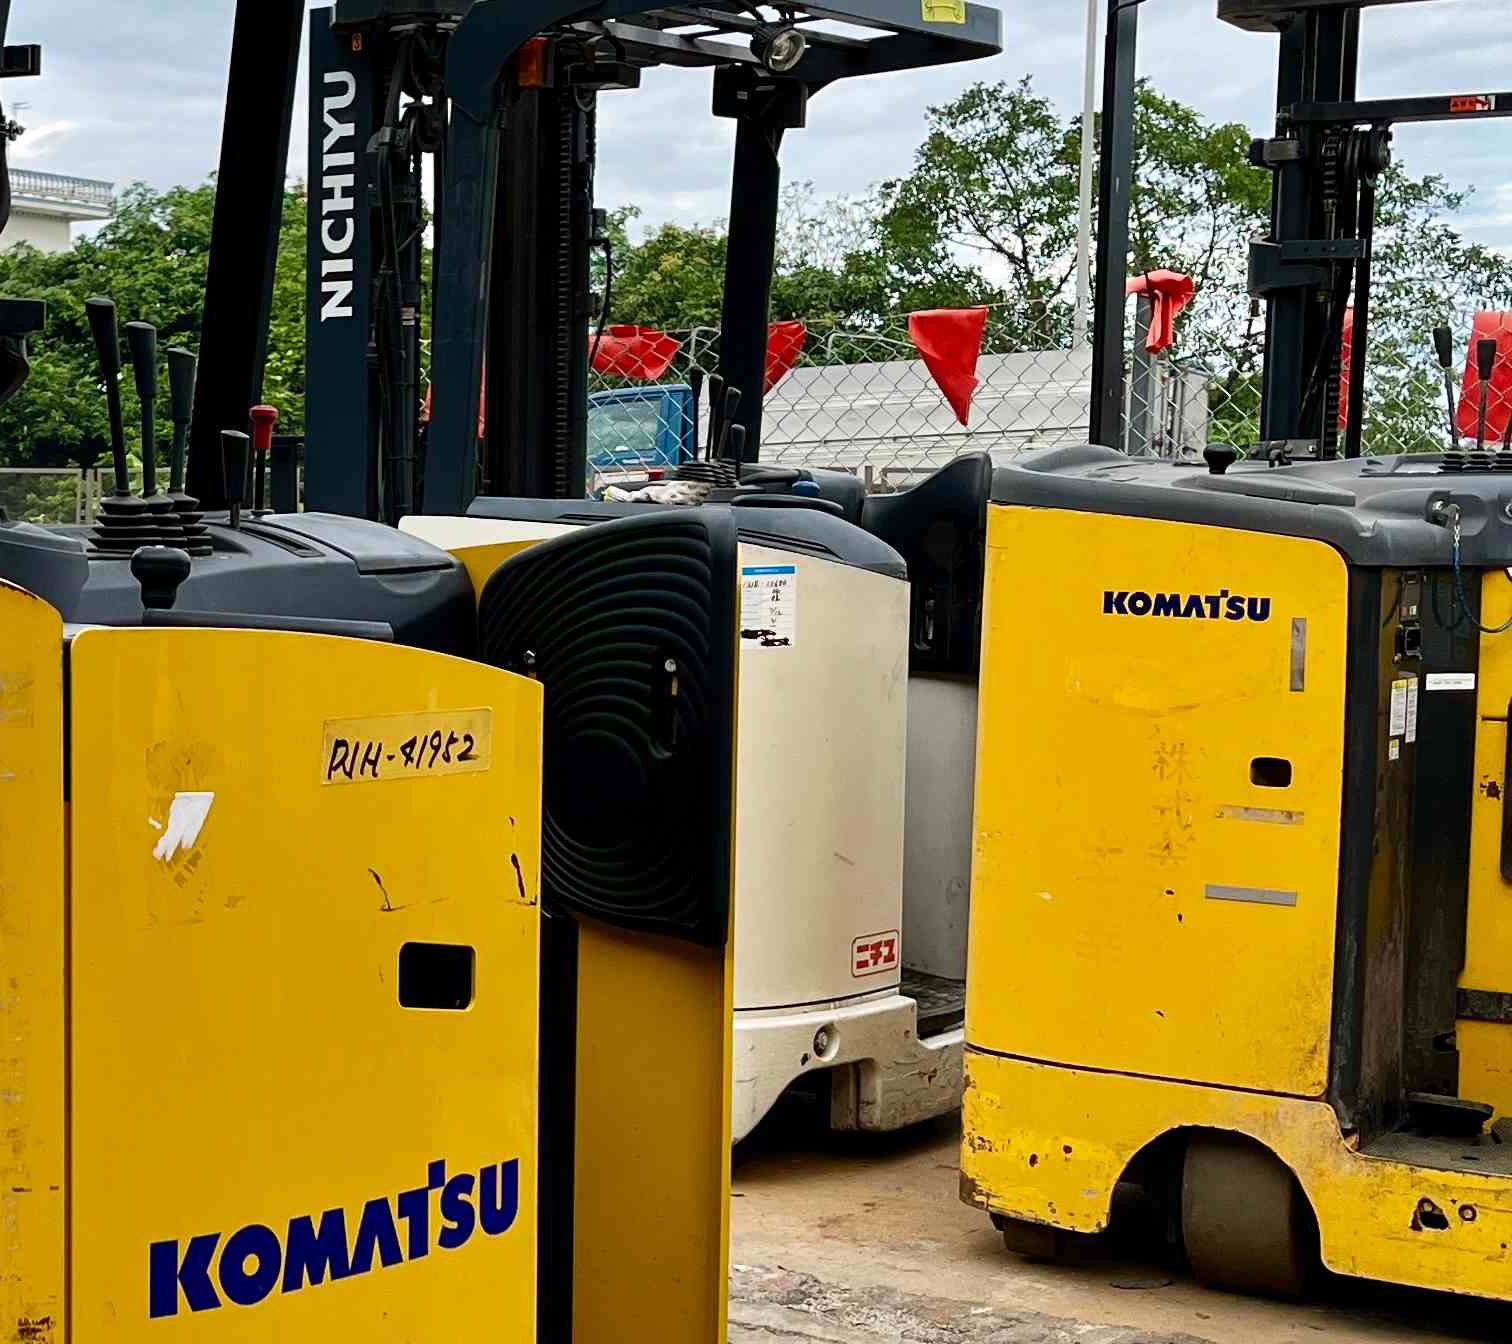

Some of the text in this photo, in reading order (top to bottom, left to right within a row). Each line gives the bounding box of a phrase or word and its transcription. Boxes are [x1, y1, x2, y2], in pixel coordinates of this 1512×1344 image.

[321, 70, 357, 322] NICHIYU
[1102, 588, 1272, 622] KOMATSU
[149, 1157, 520, 1320] KOMATSU
